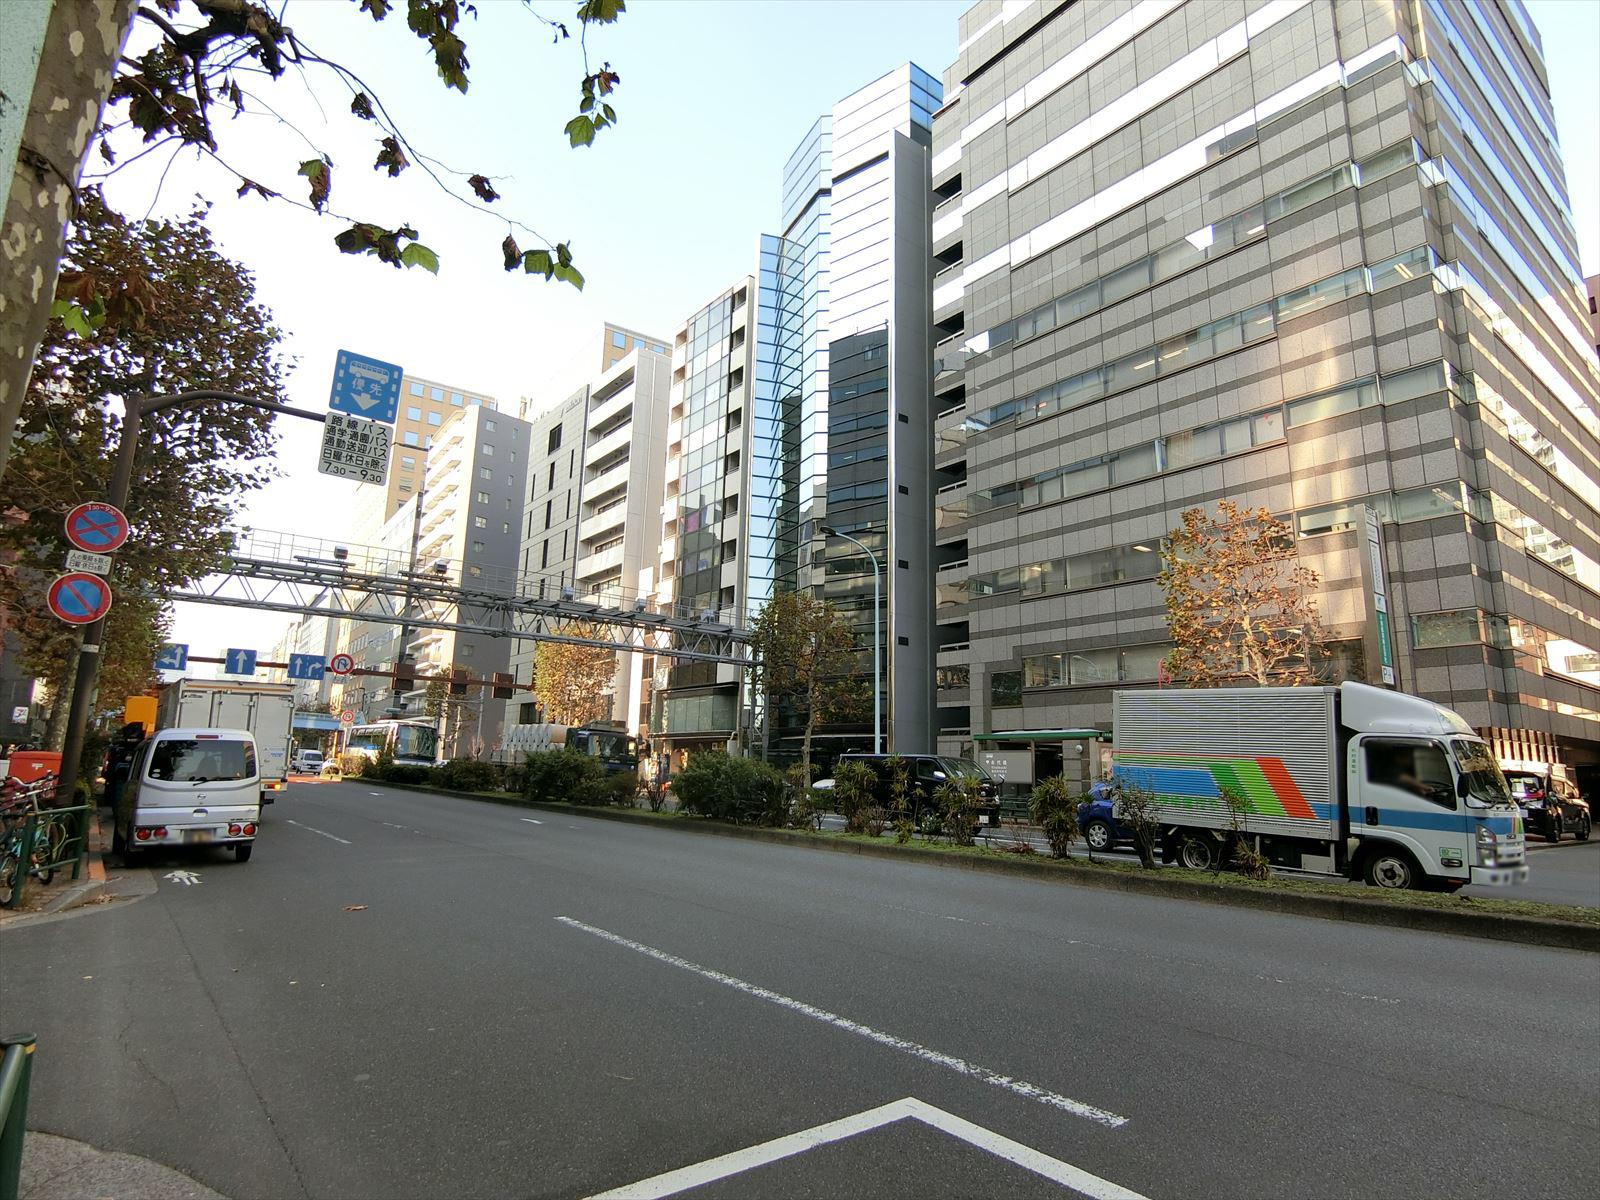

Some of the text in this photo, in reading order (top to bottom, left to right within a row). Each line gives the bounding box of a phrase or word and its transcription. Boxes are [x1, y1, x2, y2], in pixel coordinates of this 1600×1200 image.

[352, 377, 382, 397] 優先
[331, 415, 387, 438] 路線バス
[325, 435, 387, 458] 通勤送迎バス
